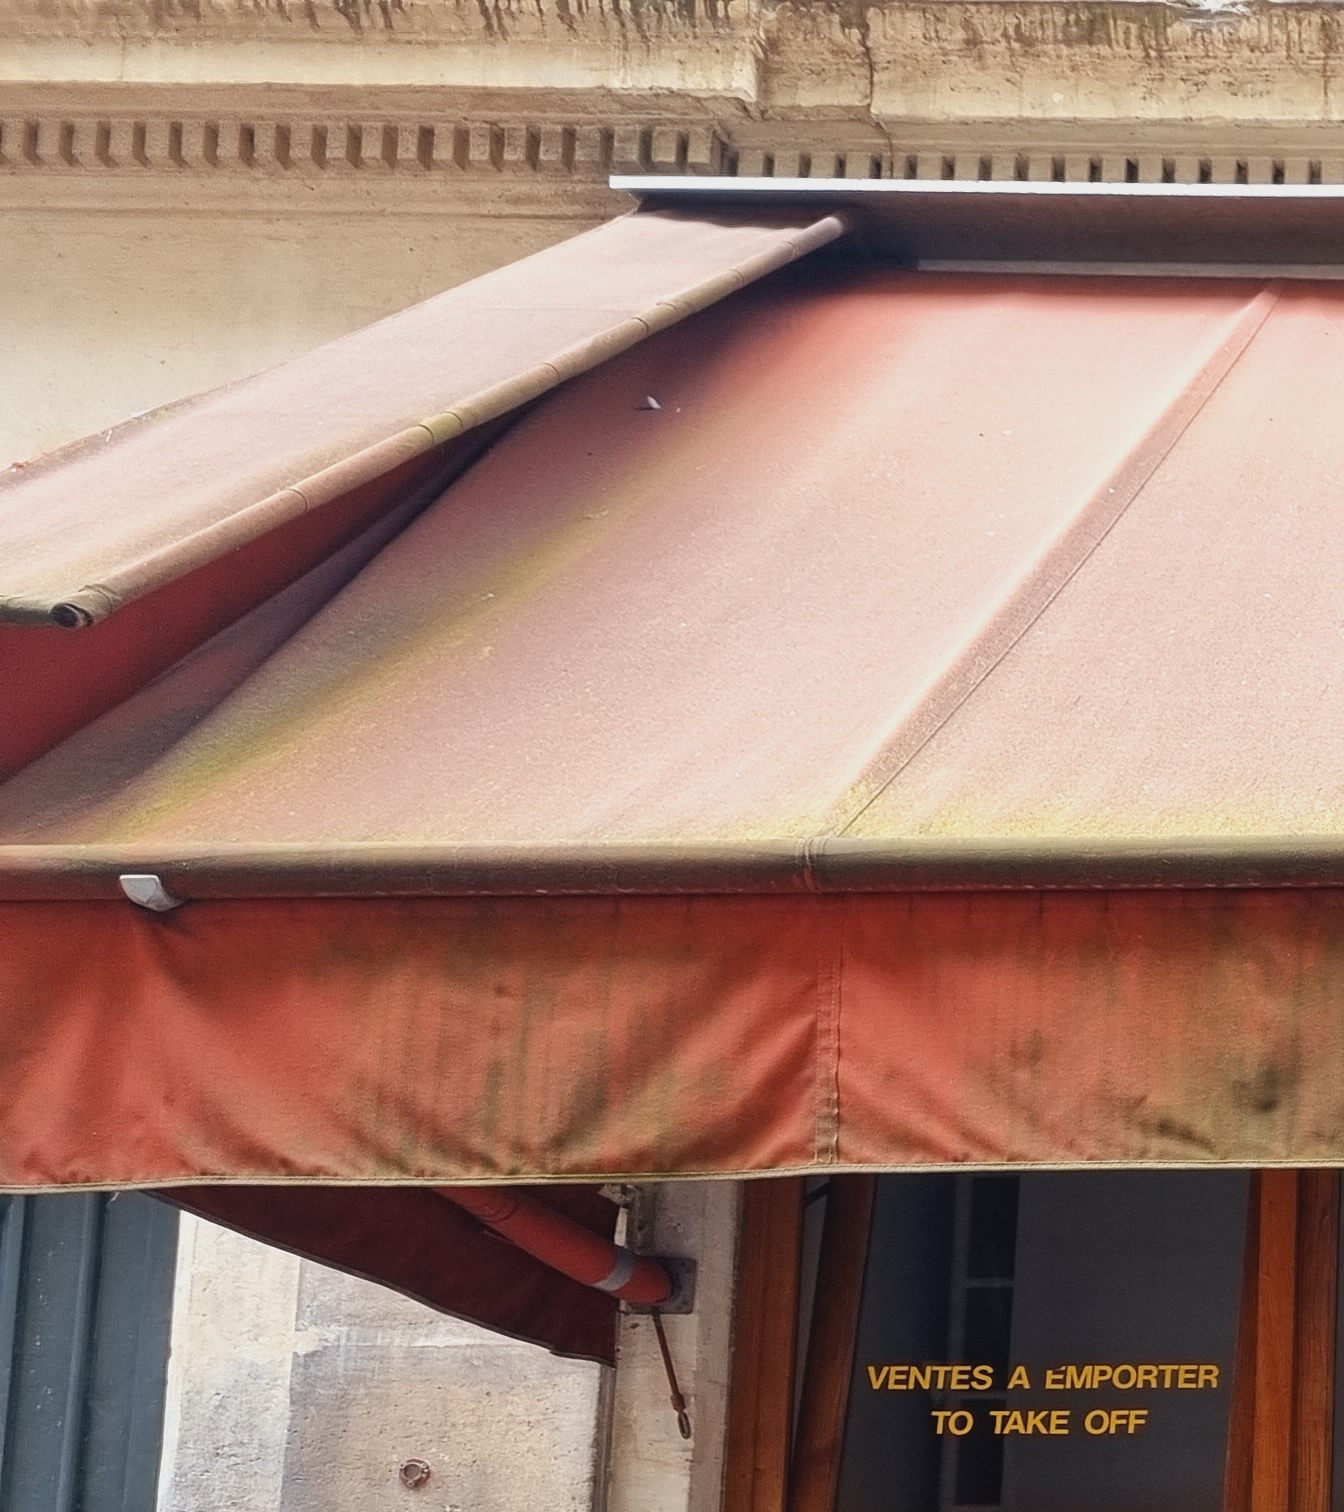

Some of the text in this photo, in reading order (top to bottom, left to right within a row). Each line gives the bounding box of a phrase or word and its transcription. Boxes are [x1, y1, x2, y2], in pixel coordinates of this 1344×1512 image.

[868, 1366, 993, 1389] VENTES
[1007, 1366, 1030, 1389] A
[931, 1410, 1148, 1435] TO TAKE OFF
